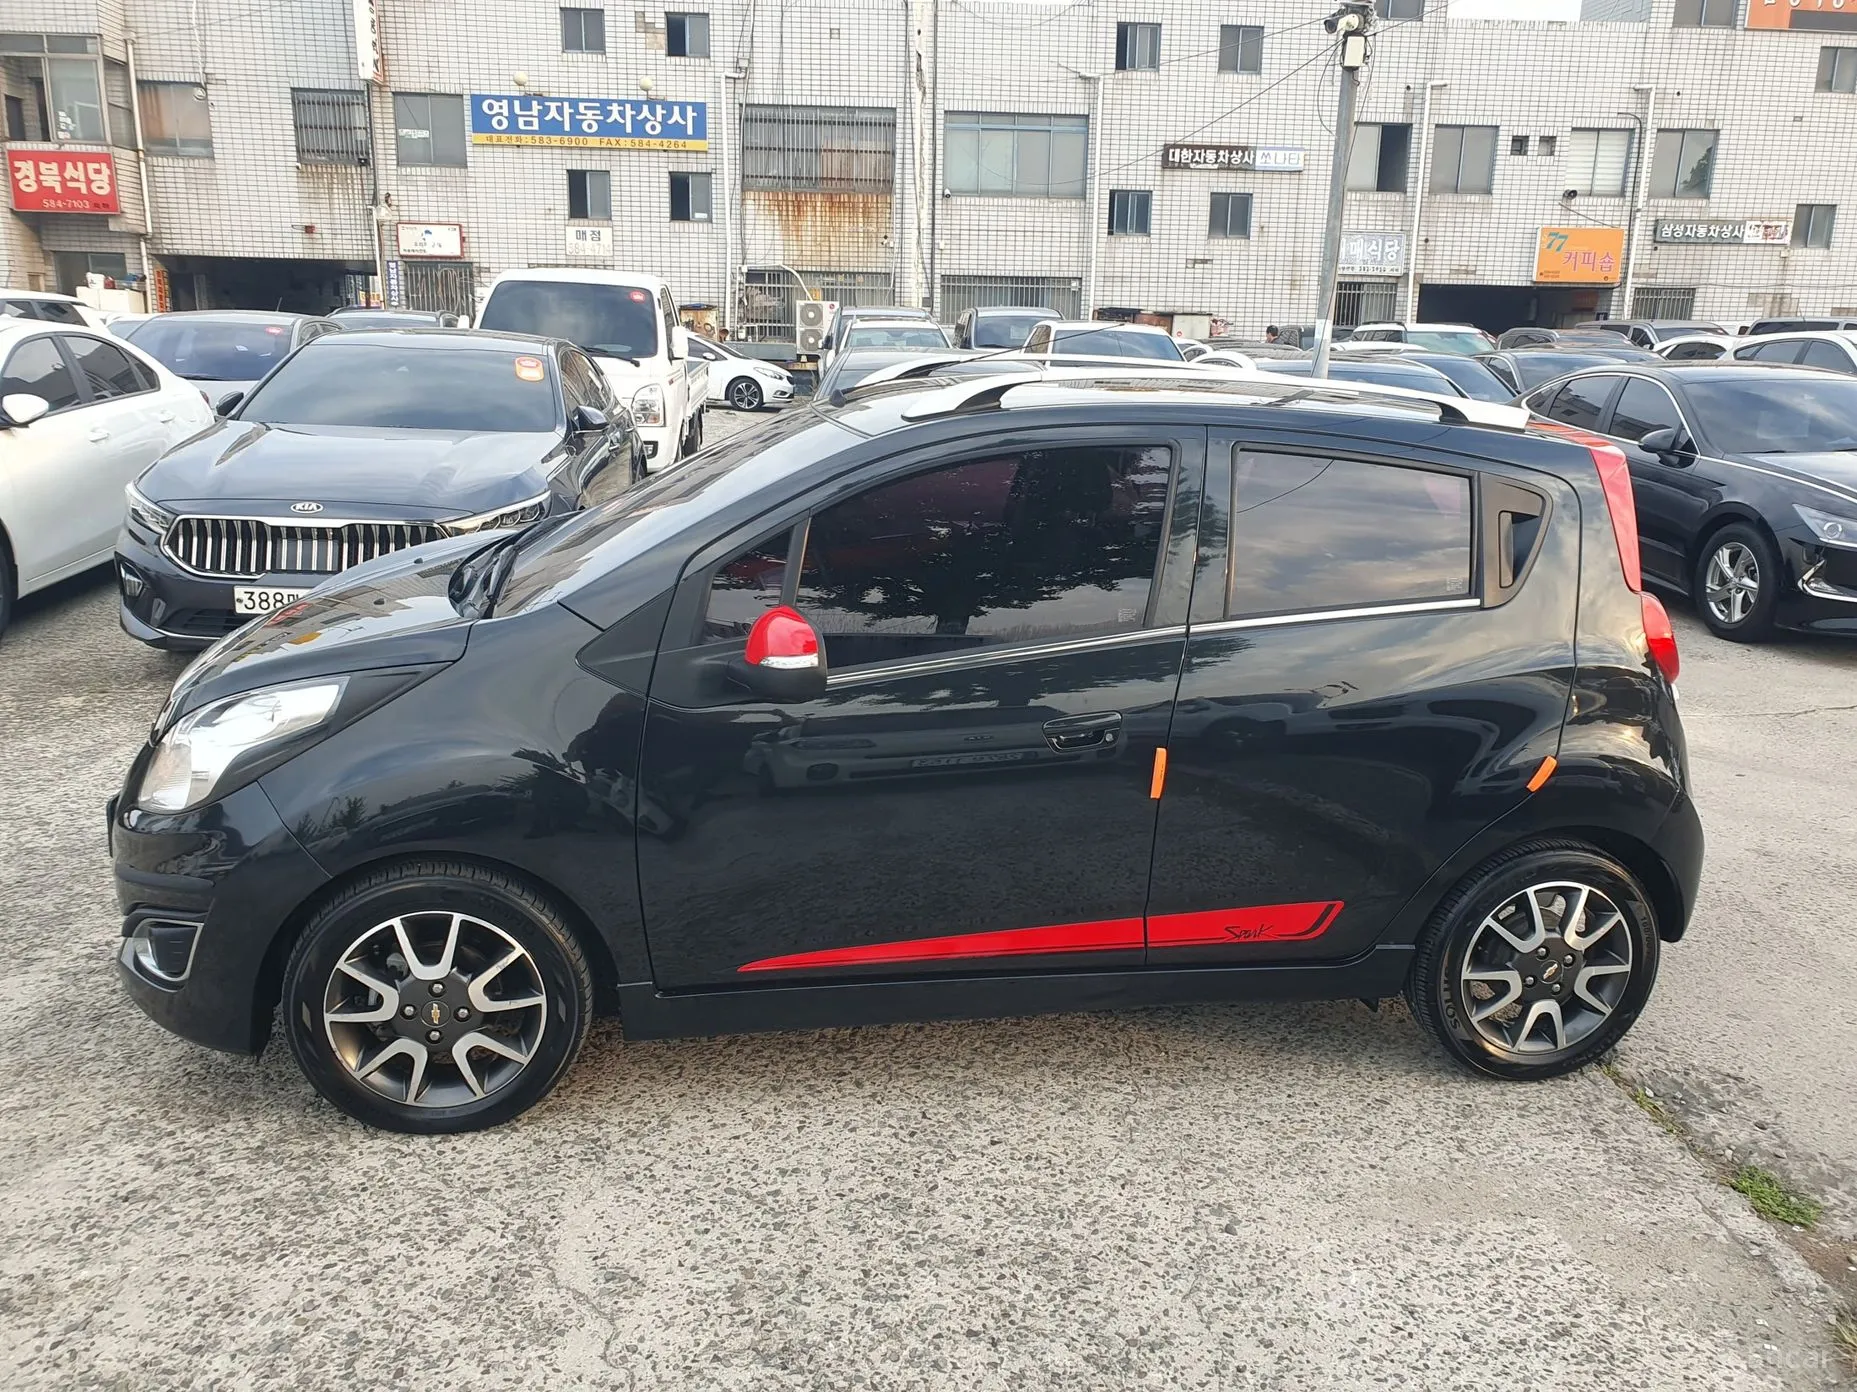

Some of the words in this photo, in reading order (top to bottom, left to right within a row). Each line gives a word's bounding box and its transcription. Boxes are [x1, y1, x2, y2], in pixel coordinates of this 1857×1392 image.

[481, 98, 698, 136] 영남자동차상사
[1168, 147, 1255, 165] 대한자동차상사
[13, 160, 111, 196] 경북식당
[42, 198, 91, 209] 584-7103
[575, 229, 602, 242] 매점
[1660, 223, 1745, 239] 삼성자동차상사
[1545, 231, 1569, 252] 77
[1562, 251, 1616, 273] 커피숍
[294, 502, 319, 512] KIA
[1224, 923, 1274, 940] Spark
